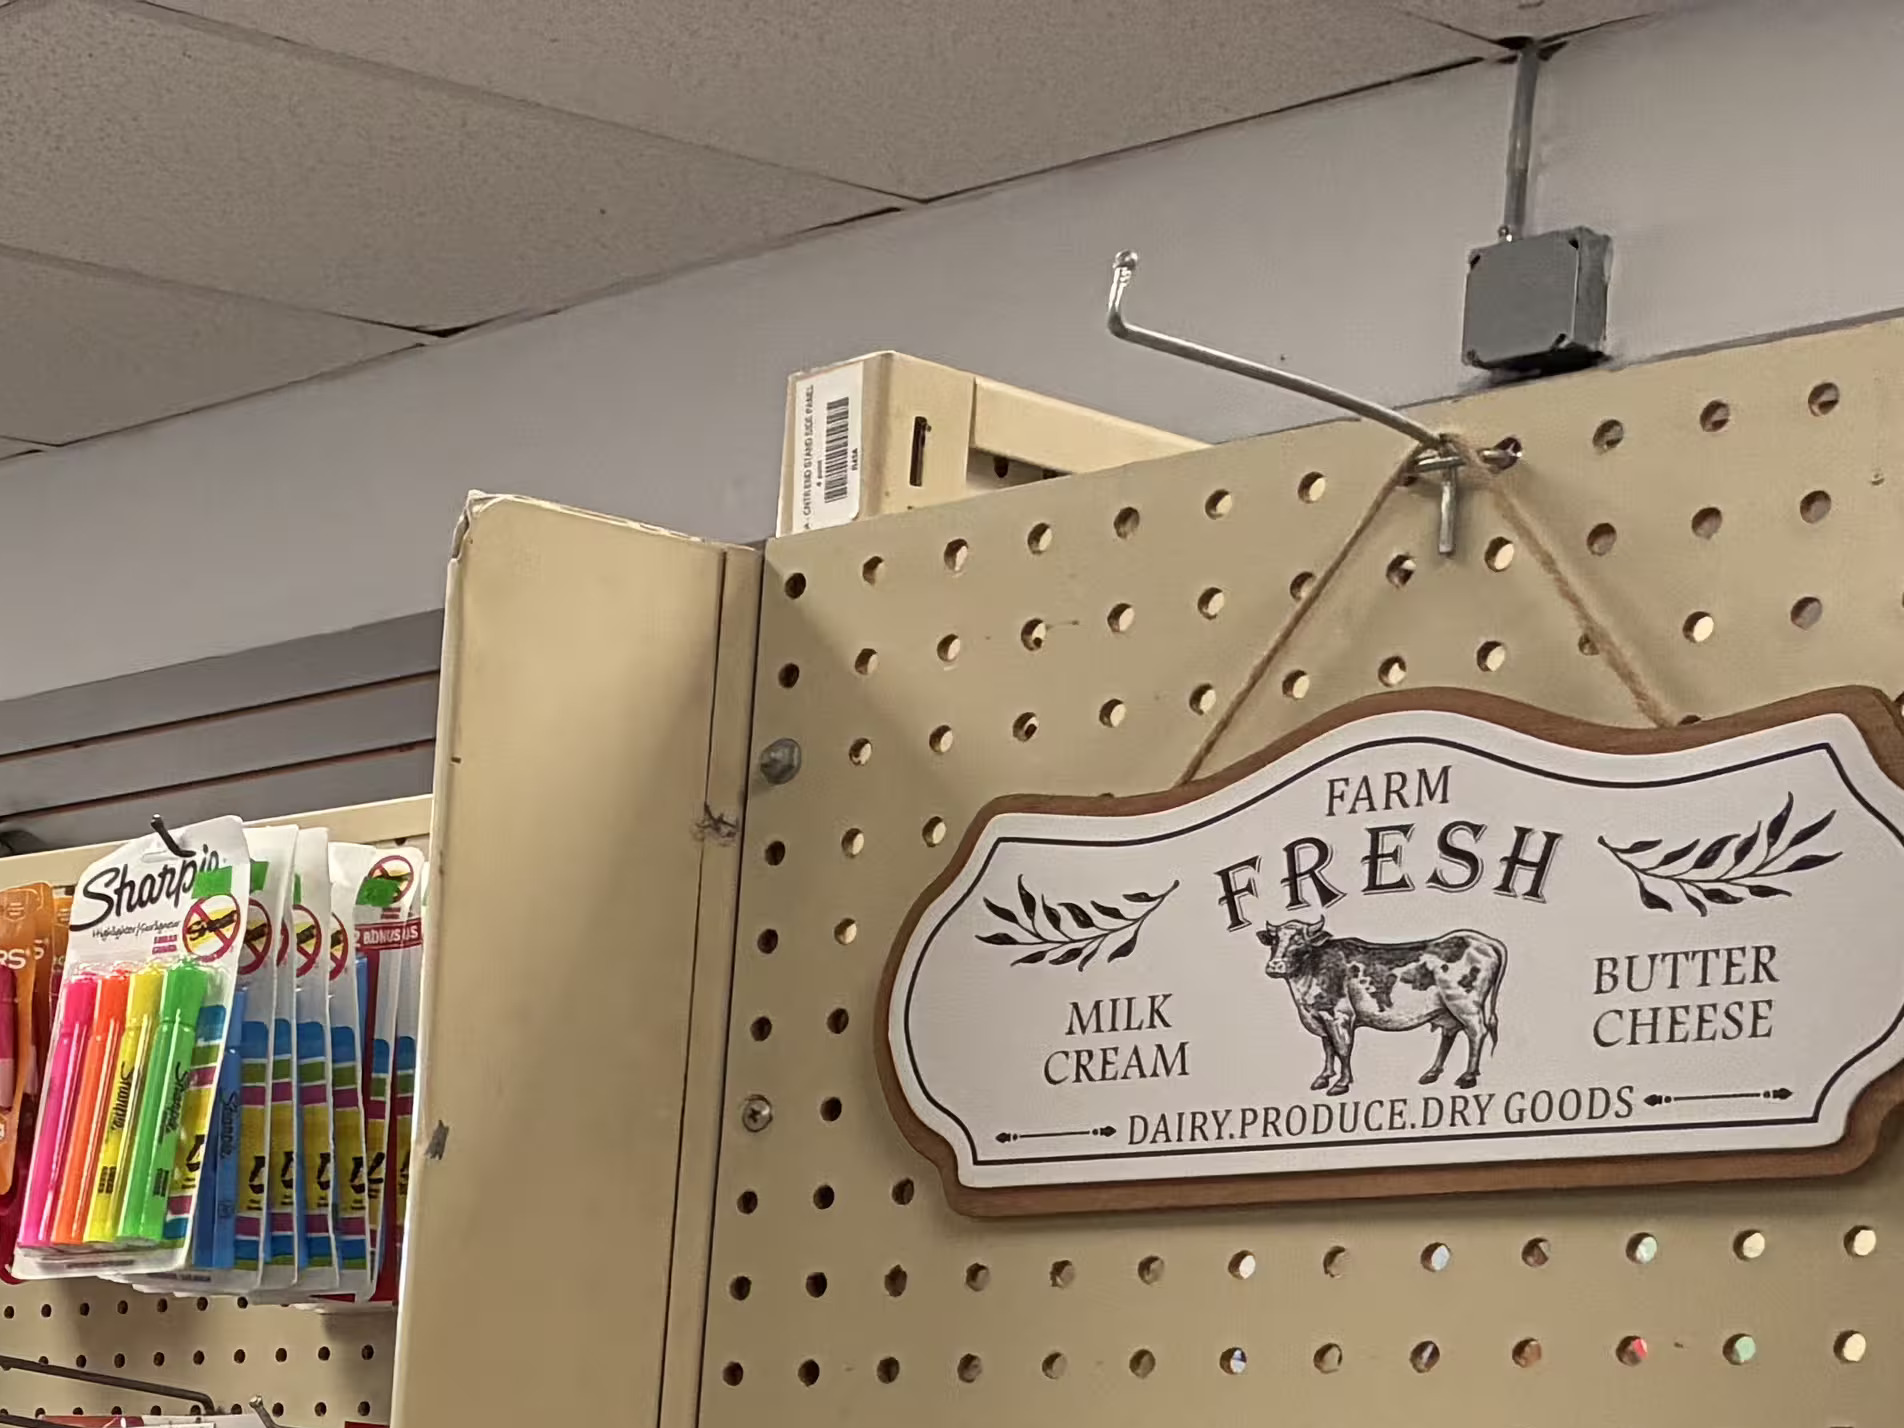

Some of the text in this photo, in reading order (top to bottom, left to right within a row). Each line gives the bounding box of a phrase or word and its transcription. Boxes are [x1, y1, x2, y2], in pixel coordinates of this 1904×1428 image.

[1325, 764, 1452, 818] FARM
[70, 843, 220, 932] Sharpie
[1212, 819, 1564, 934] FRESH
[1591, 943, 1780, 996] BUTTER
[1065, 992, 1174, 1037] MILK
[1590, 999, 1776, 1050] CHEESE
[1042, 1040, 1191, 1087] CREAM
[1502, 1084, 1637, 1127] GOODS
